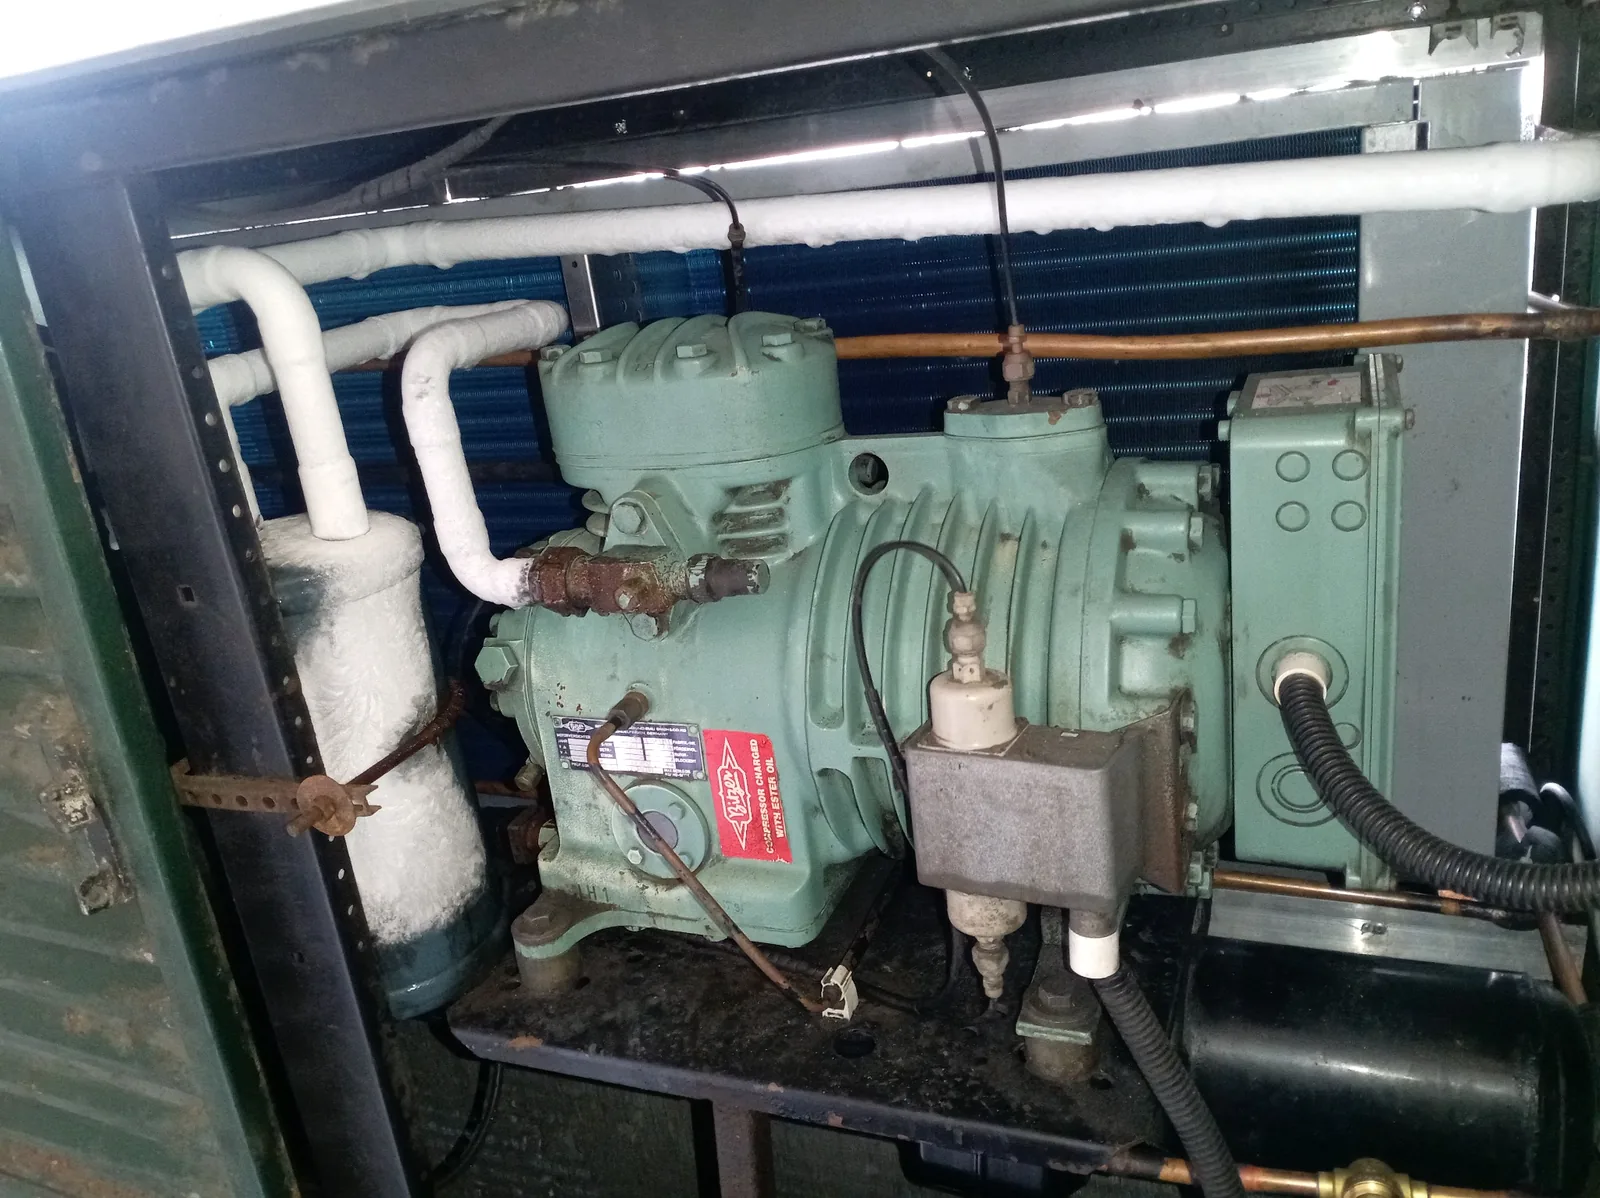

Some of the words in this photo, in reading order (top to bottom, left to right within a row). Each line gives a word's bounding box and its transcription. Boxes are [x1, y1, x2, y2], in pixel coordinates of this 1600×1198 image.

[749, 739, 764, 786] CHARGED
[765, 757, 775, 774] OIL
[723, 770, 748, 819] Bitzer
[768, 776, 780, 810] ESTER
[758, 788, 774, 854] COMPRESSOR
[772, 811, 784, 839] WITH
